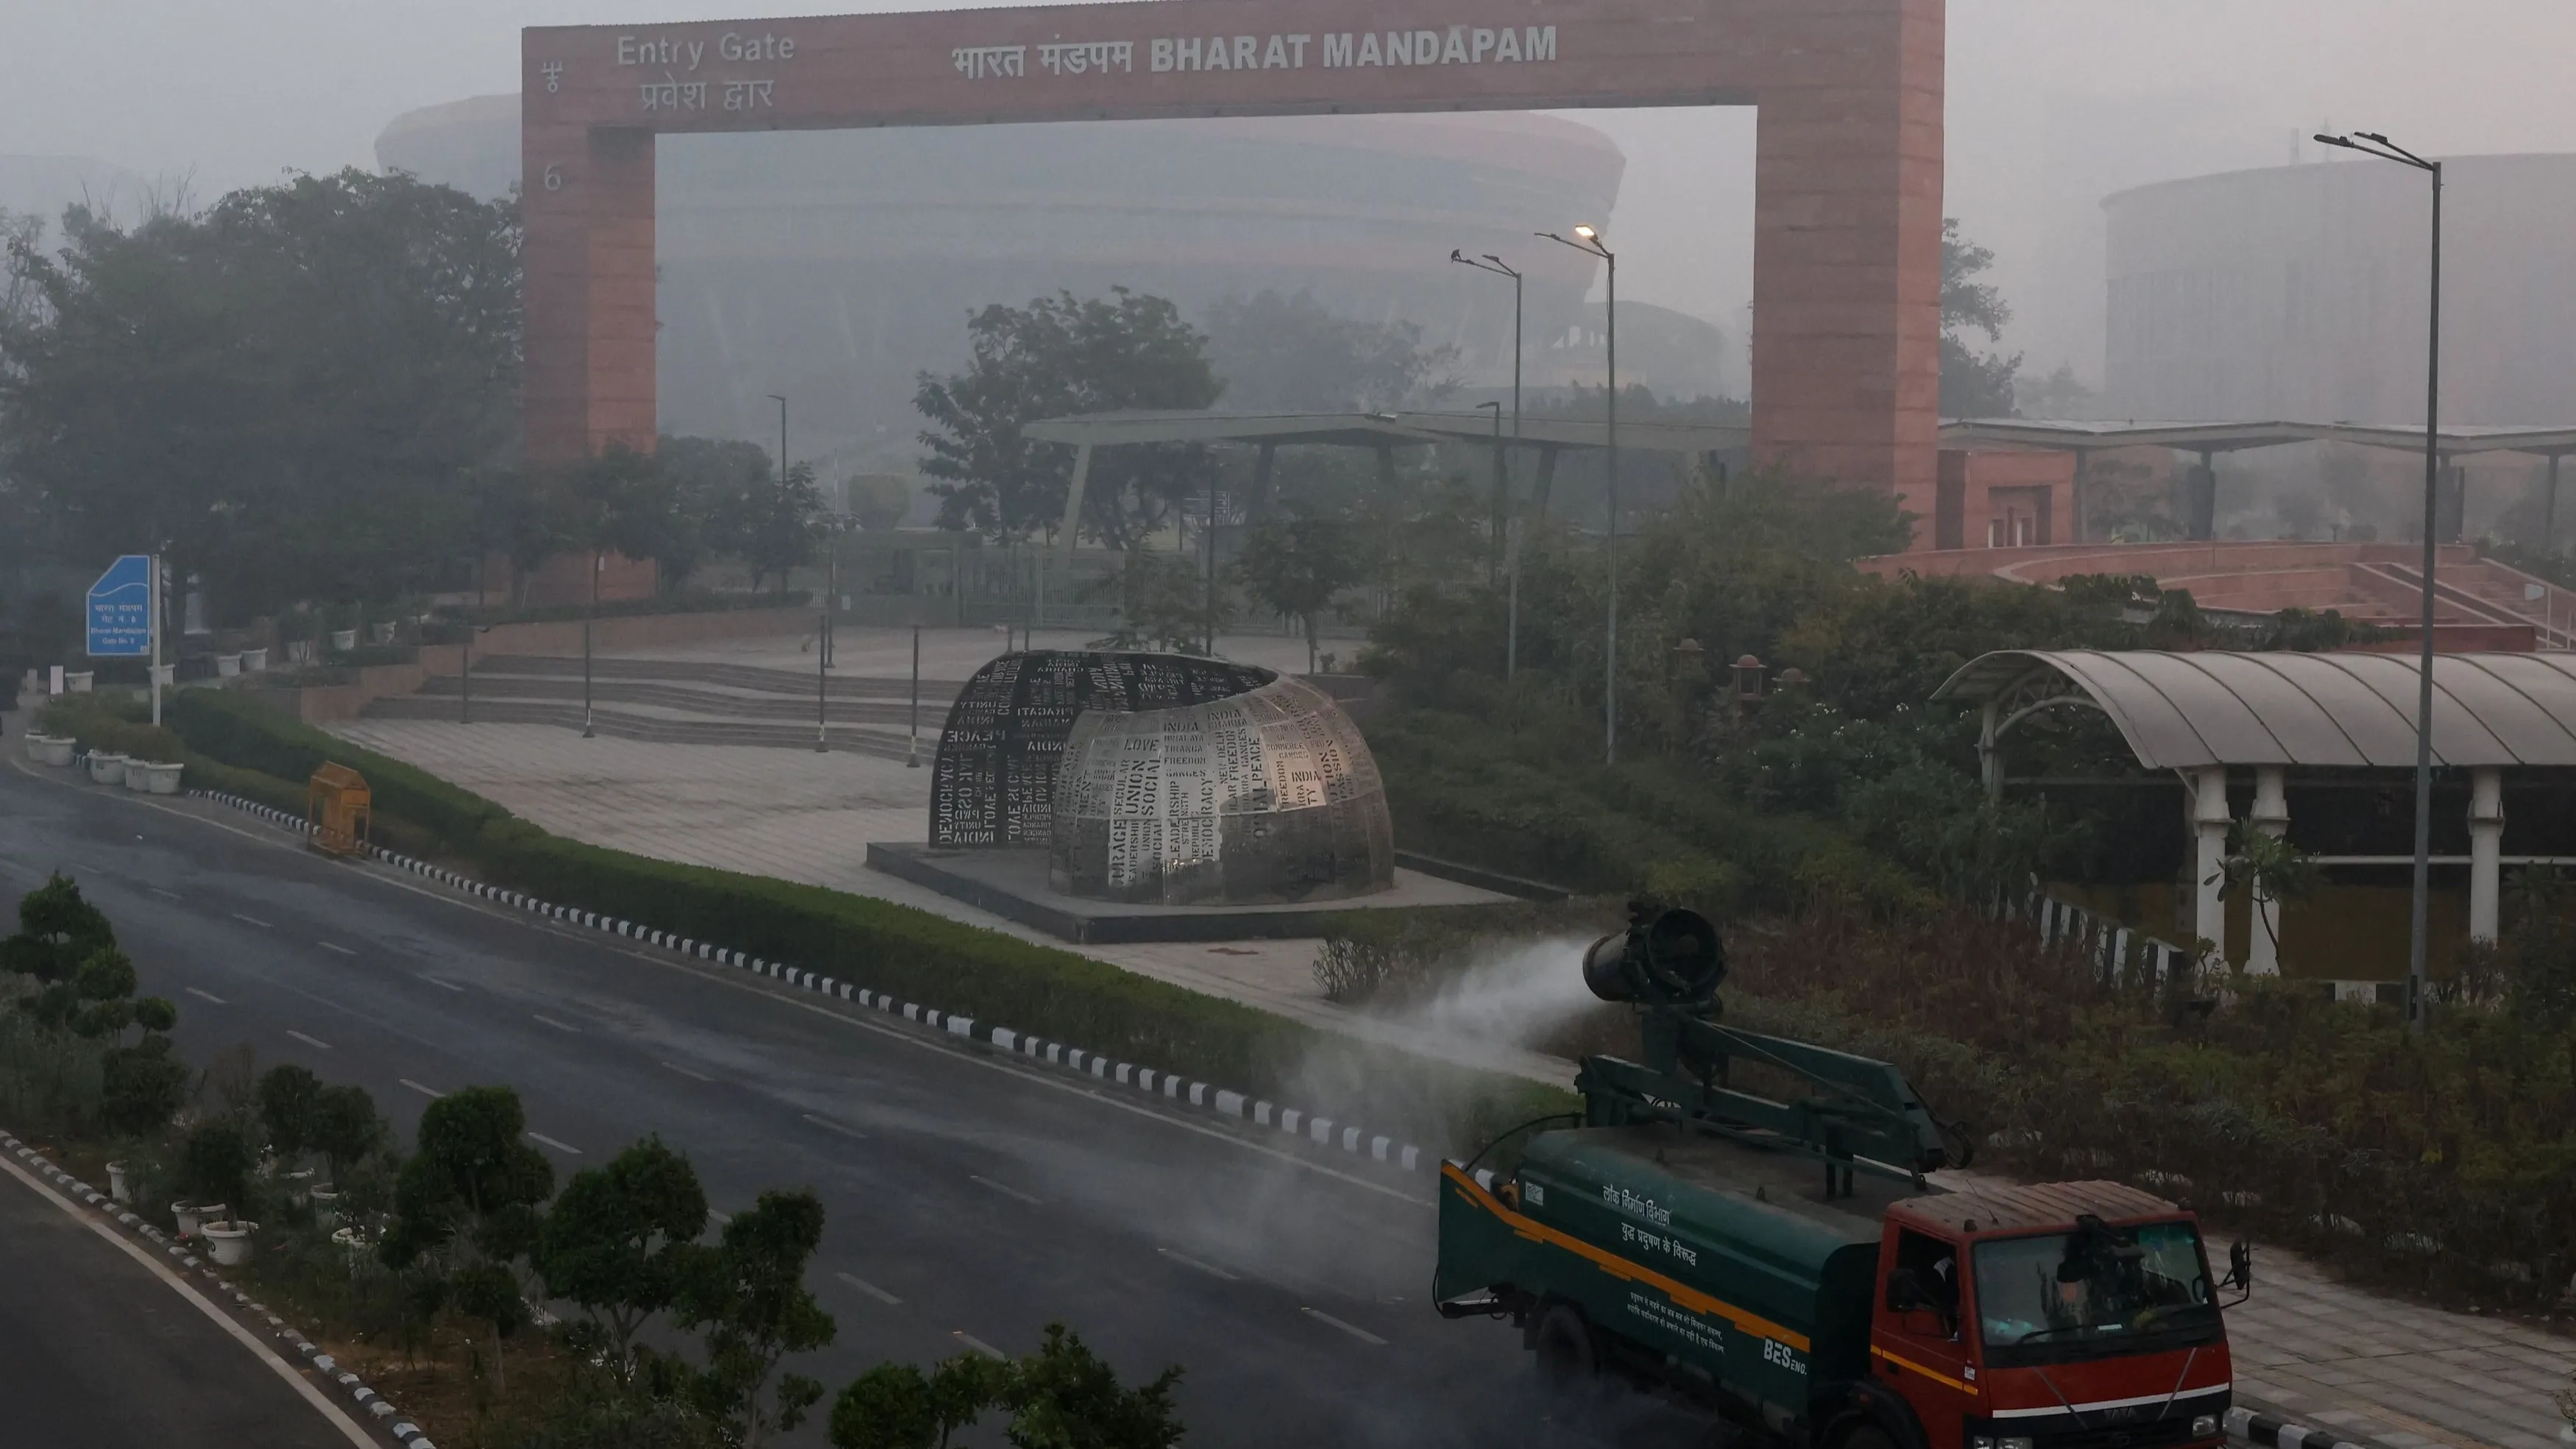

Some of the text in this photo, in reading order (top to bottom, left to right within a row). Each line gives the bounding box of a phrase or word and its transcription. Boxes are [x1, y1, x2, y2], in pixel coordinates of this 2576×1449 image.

[618, 32, 796, 71] Entry Gate
[951, 33, 1134, 79] भारत मंडपम
[1150, 25, 1557, 72] BHARAT MANDAPAM
[639, 71, 775, 111] प्रवेश द्वार
[543, 160, 563, 191] 6
[1124, 738, 1160, 751] LOVE
[1164, 722, 1200, 732] INDIA
[1164, 757, 1206, 765] FREEDOM
[1225, 728, 1239, 781] FREEDOM
[1249, 736, 1263, 782] PEACE
[1114, 759, 1130, 815] SECULAR
[1125, 759, 1146, 815] UNION
[1141, 754, 1161, 816] SOCIAL
[1291, 770, 1322, 782] INDIA
[1142, 819, 1152, 851] UNION
[1603, 1183, 1620, 1205] लोक
[1621, 1188, 1645, 1216] निर्माण
[1621, 1222, 1635, 1241] युद्ध
[1663, 1236, 1671, 1253] के
